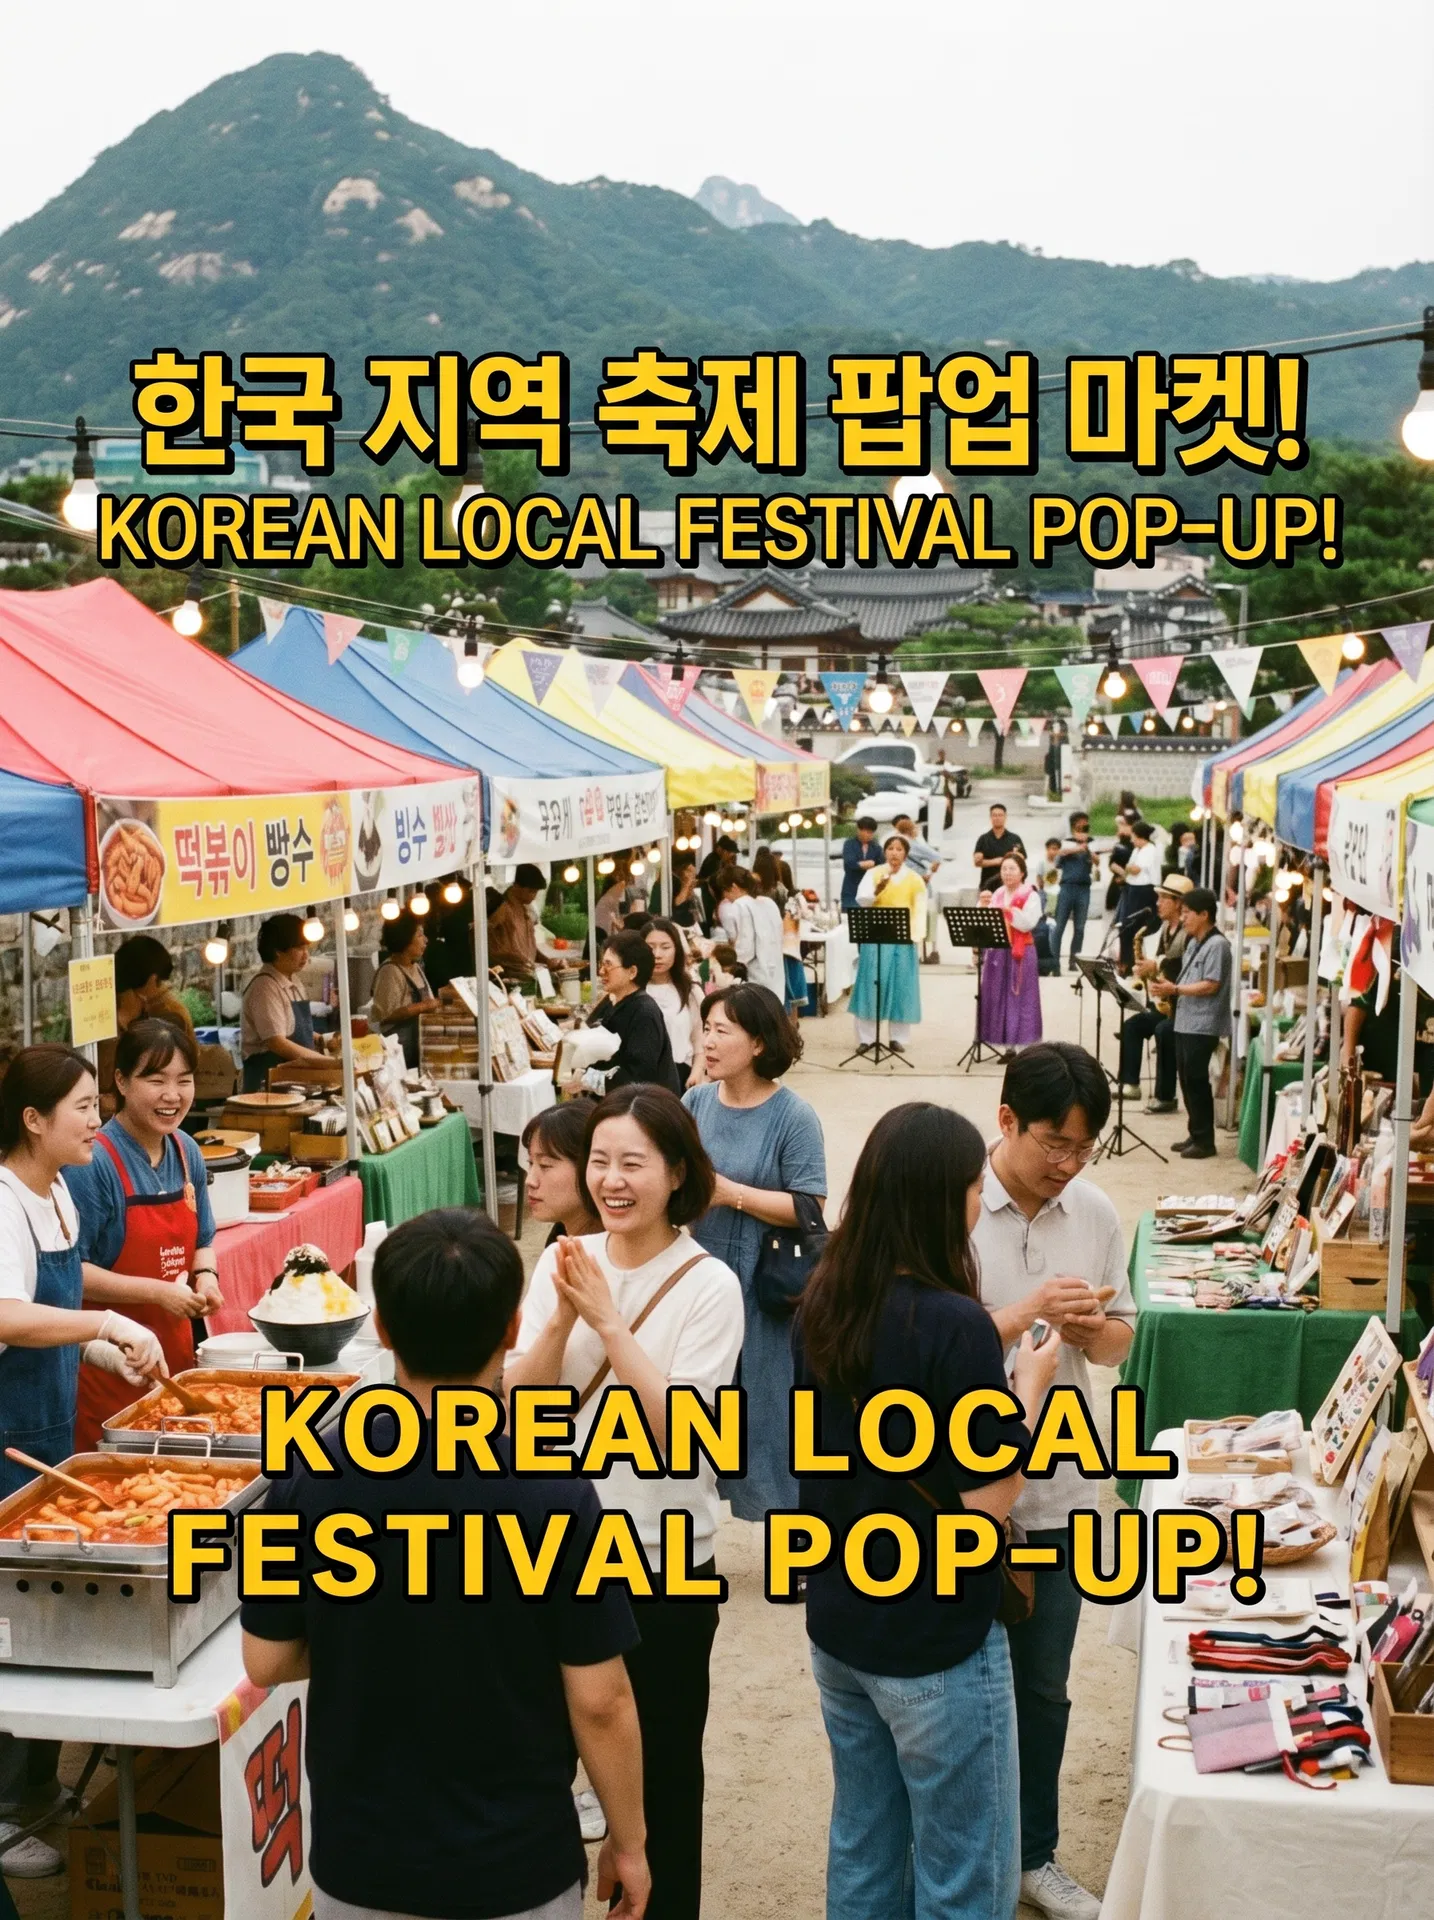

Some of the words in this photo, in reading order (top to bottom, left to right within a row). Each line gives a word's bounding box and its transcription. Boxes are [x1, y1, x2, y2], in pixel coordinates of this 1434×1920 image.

[173, 819, 257, 899] 떡볶이
[394, 805, 428, 865] 빙수
[244, 1697, 303, 1889] 떡
